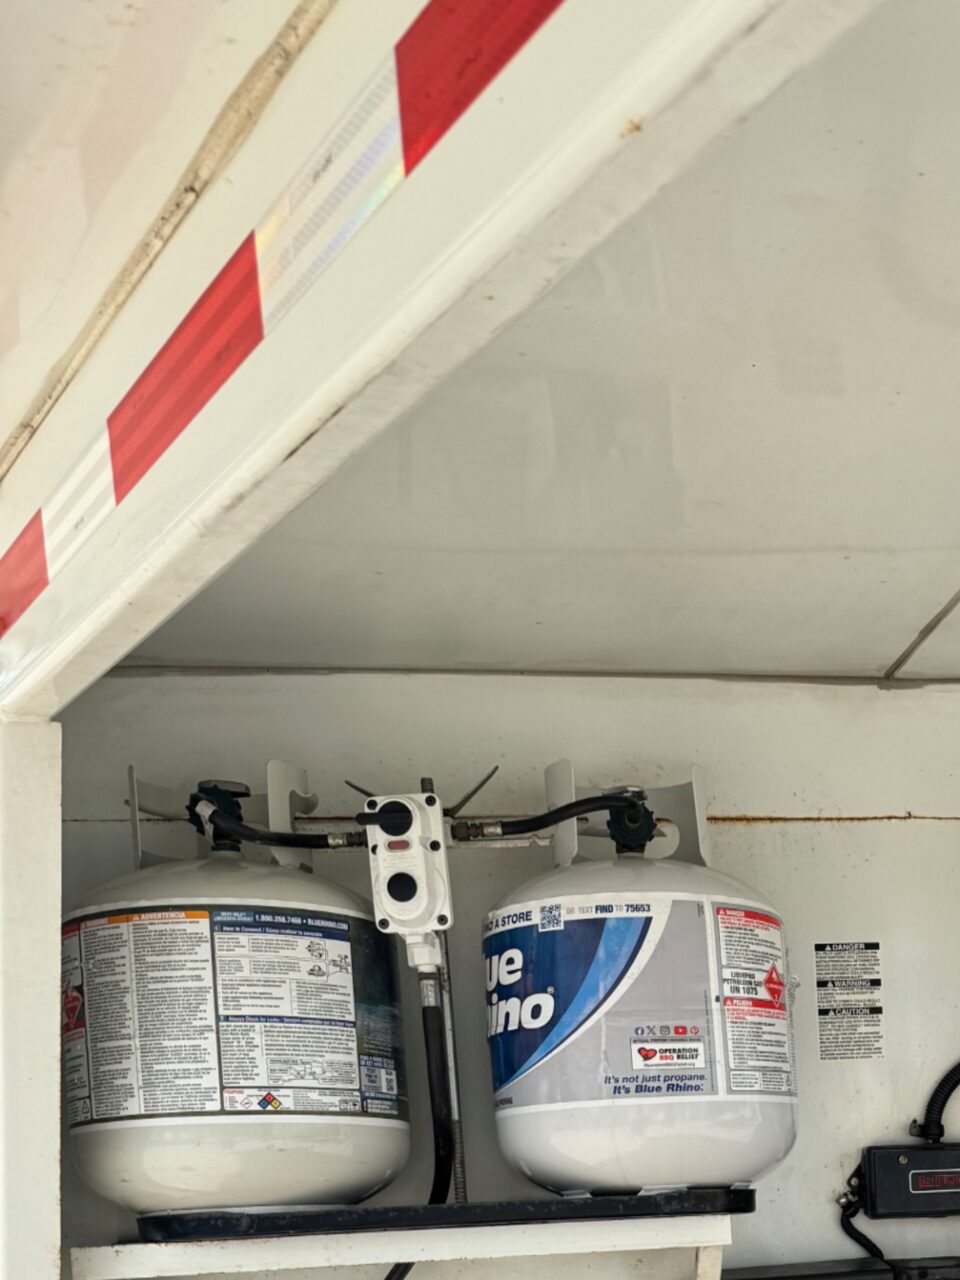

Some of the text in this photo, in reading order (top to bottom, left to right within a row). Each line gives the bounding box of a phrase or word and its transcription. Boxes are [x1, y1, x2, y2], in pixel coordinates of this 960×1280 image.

[578, 906, 593, 915] TEXT
[594, 905, 614, 915] FIND
[625, 904, 651, 913] 75653
[501, 910, 532, 927] STORE
[832, 943, 865, 951] DANGER
[730, 986, 740, 994] UN
[742, 986, 758, 995] 1075
[836, 1008, 870, 1016] CAUTION
[604, 1073, 707, 1084] It's not just propane.
[612, 1085, 631, 1095] It's
[634, 1084, 662, 1093] Blue
